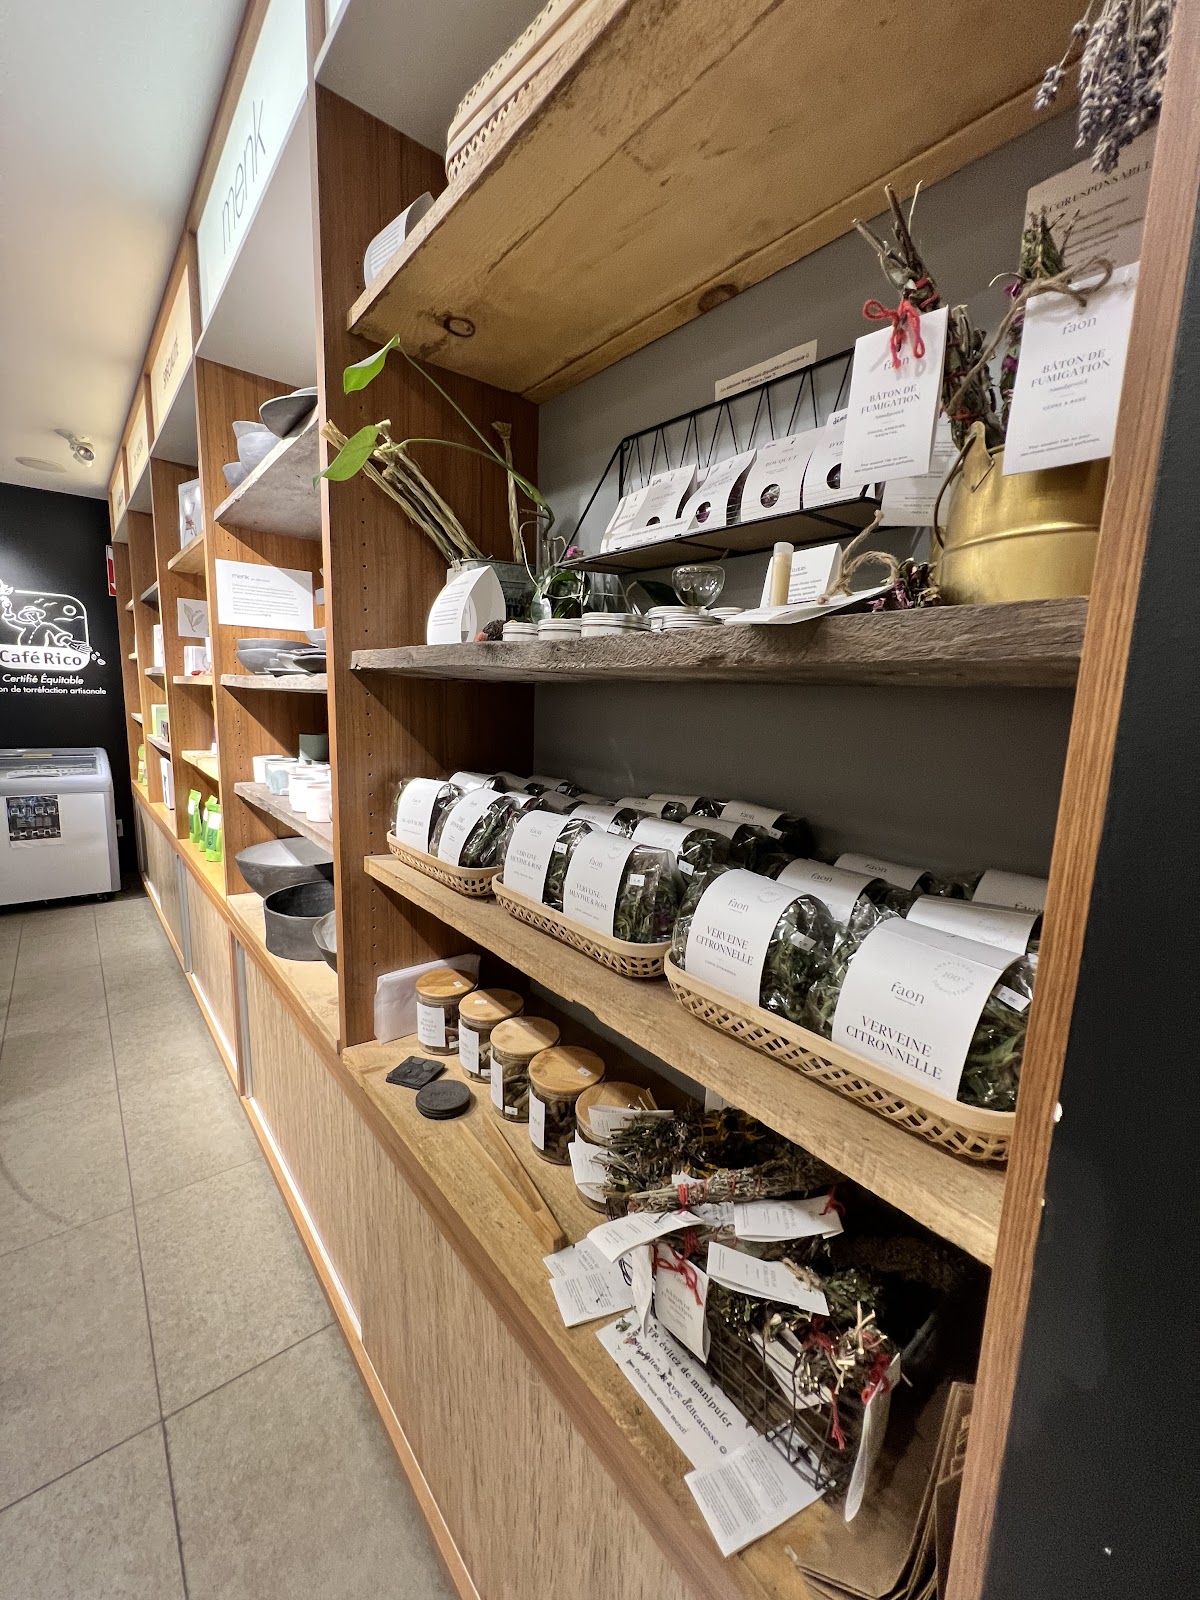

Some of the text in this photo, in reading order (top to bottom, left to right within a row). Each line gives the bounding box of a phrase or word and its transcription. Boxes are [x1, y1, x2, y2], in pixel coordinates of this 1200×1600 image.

[222, 98, 266, 255] menk
[1062, 317, 1097, 335] faon
[884, 356, 910, 371] fan
[1042, 348, 1106, 374] BÂTON DE
[1031, 359, 1112, 388] FUMIGATION
[869, 383, 918, 402] BÂTON DE
[861, 393, 921, 414] FUMIGATION
[0, 650, 82, 666] Café Rico
[2, 672, 84, 685] Certifié Équitable
[10, 685, 21, 693] de
[23, 685, 69, 695] torréfaction
[69, 687, 107, 695] artisanale
[588, 857, 603, 869] faon
[811, 872, 833, 883] faon
[594, 901, 609, 911] ROSE
[728, 898, 749, 912] faon
[706, 925, 748, 950] VERVEINE
[696, 934, 754, 966] CITRONNELLE
[890, 981, 925, 1004] faon
[862, 1015, 932, 1058] VERVEINE
[846, 1025, 943, 1080] CITRONNELLE
[659, 1341, 681, 1367] évitez
[681, 1367, 692, 1379] de
[690, 1379, 732, 1428] manipuler
[667, 1381, 683, 1399] avec
[682, 1398, 719, 1446] délicatesse
